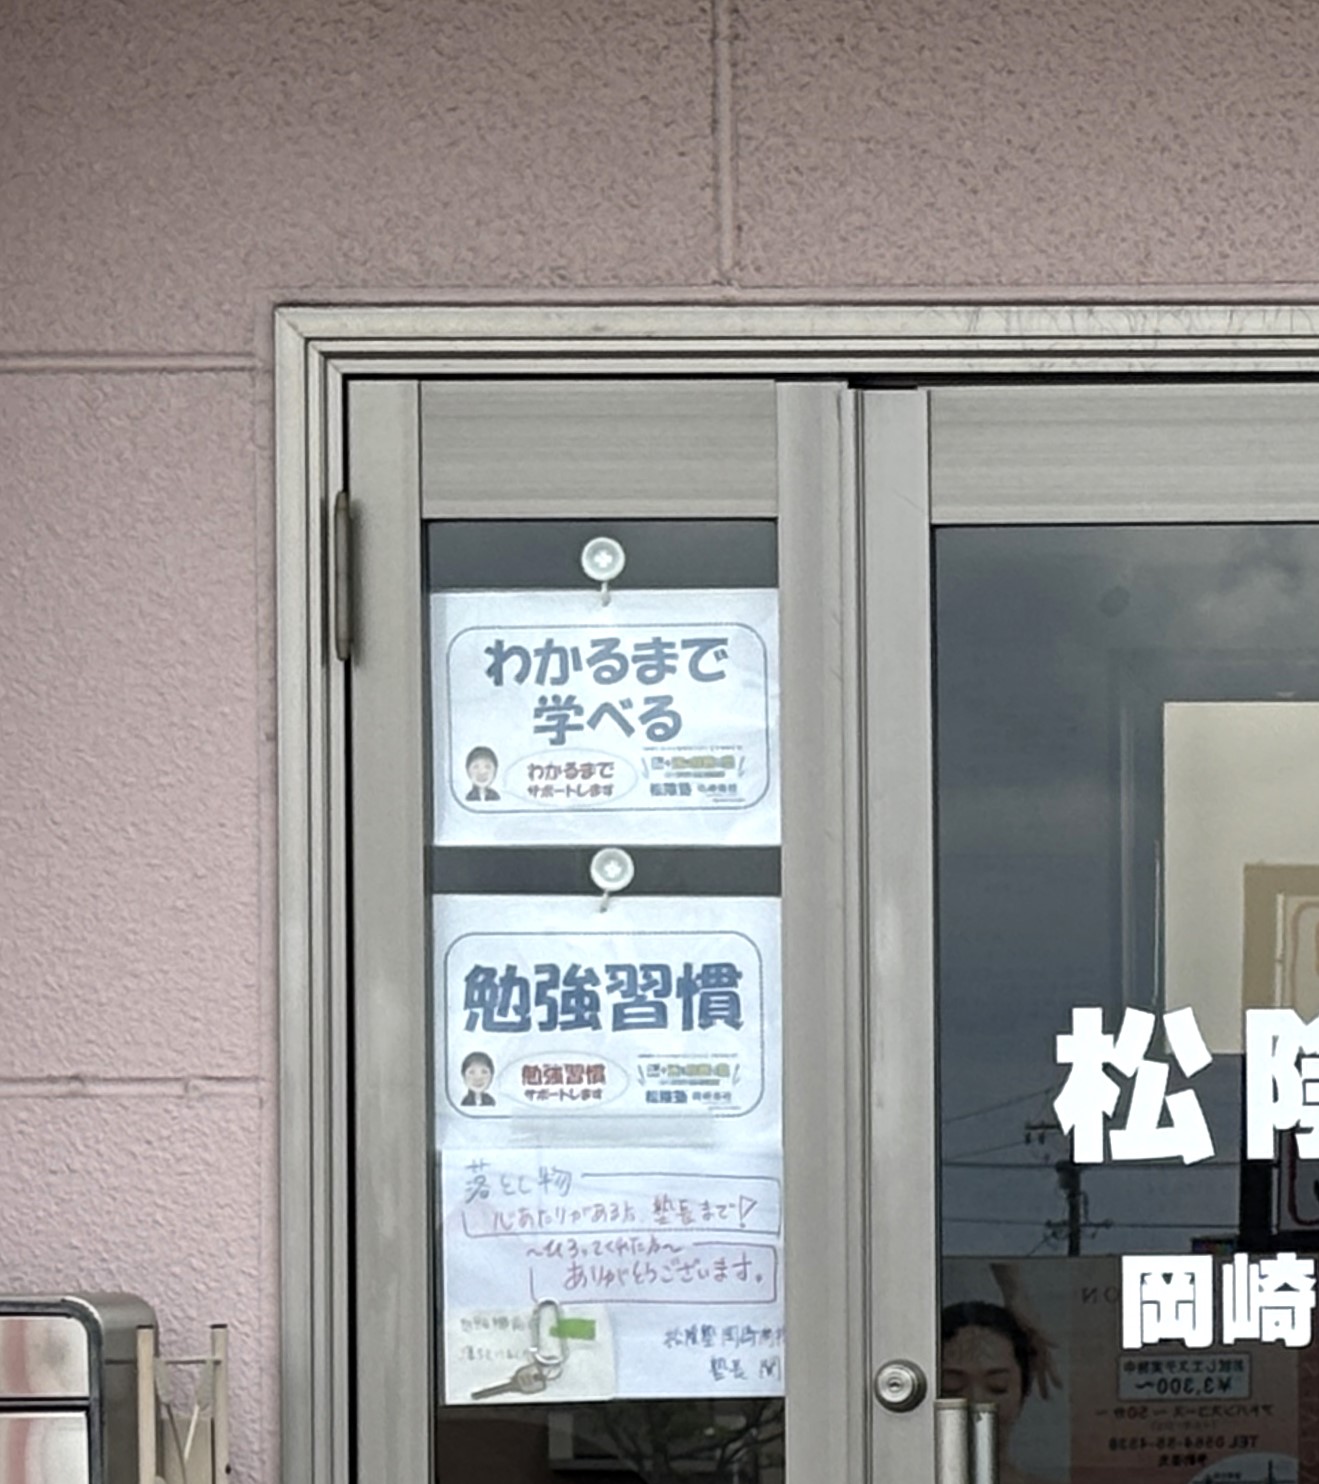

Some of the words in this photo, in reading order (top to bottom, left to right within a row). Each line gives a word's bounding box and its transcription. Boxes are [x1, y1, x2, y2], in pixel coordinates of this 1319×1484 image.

[484, 637, 728, 687] わかるまで
[533, 694, 682, 746] 学べる
[527, 761, 614, 781] わかるまで
[527, 783, 614, 798] サポートします
[463, 962, 745, 1033] 勉強習慣
[522, 1063, 606, 1086] 勉強習慣
[464, 1159, 573, 1204] 落とし物
